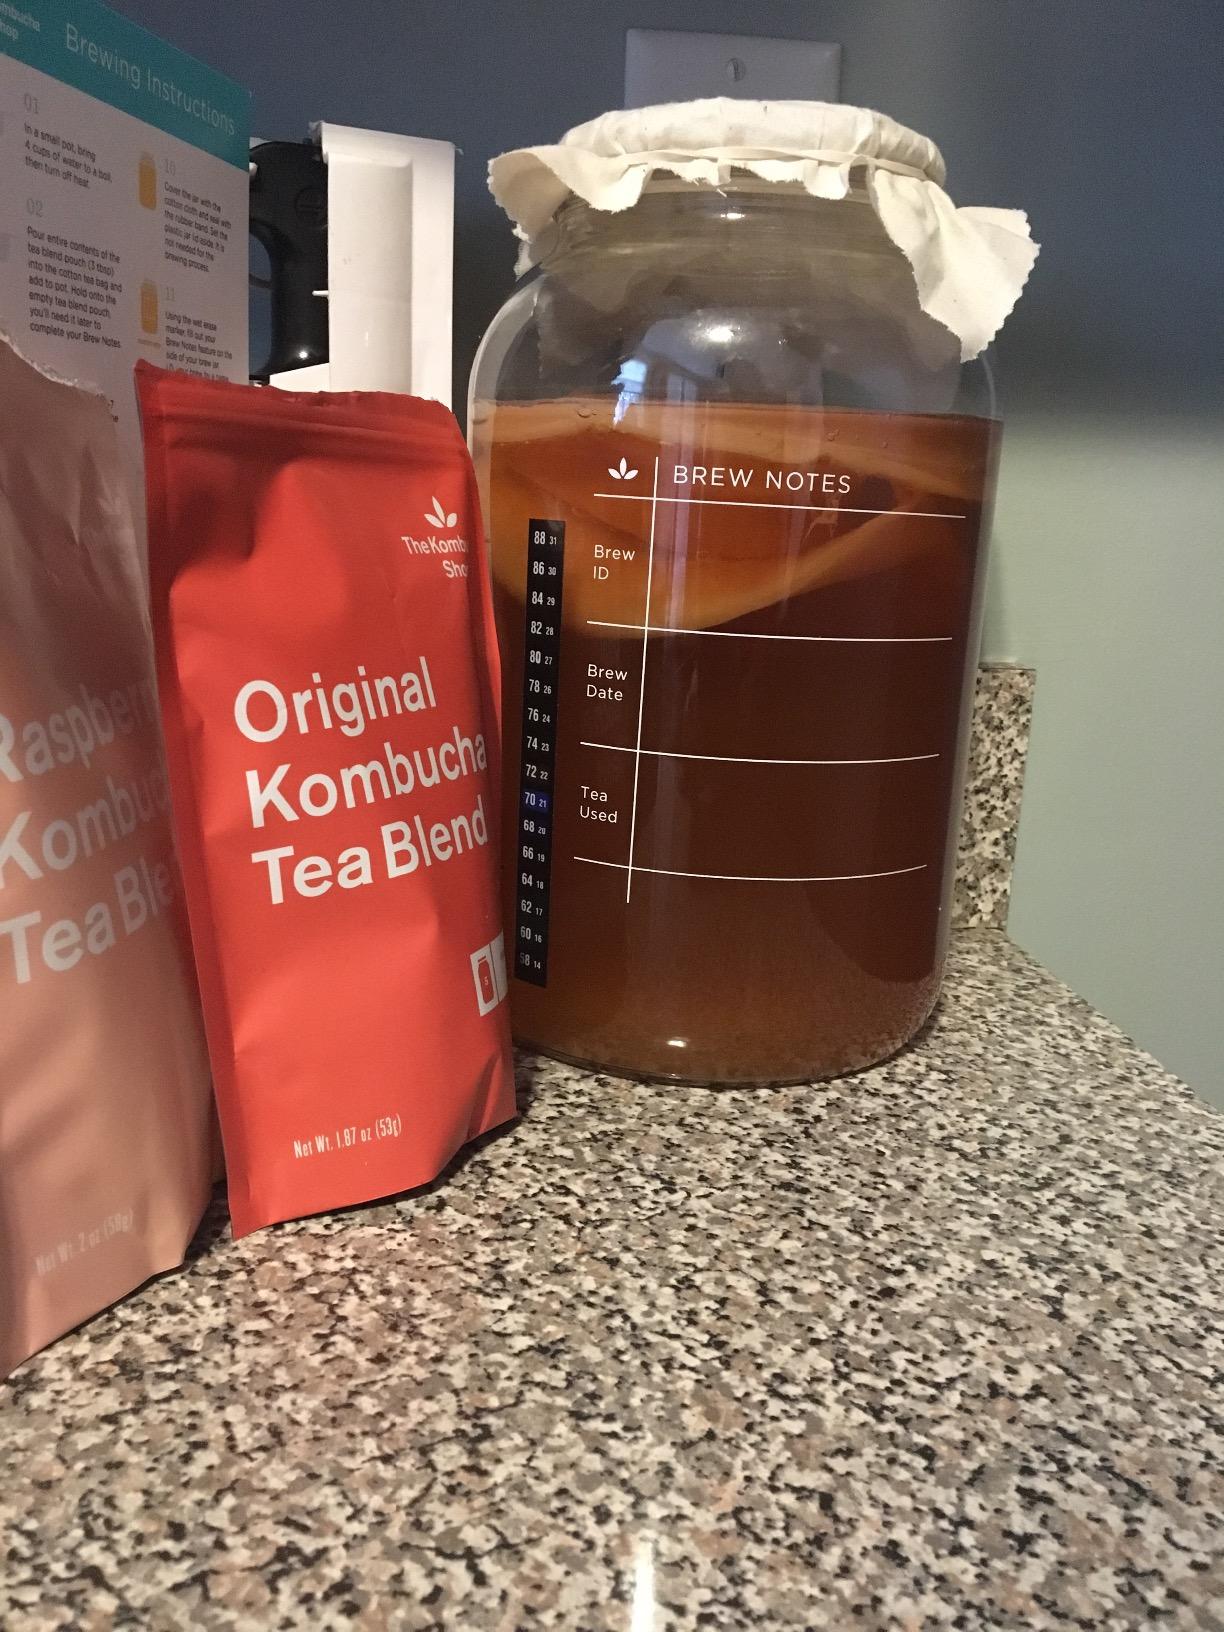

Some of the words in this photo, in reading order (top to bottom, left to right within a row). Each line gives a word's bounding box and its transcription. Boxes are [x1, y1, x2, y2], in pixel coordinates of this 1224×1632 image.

[65, 22, 142, 90] Brewing
[147, 67, 236, 136] Instructions
[41, 131, 61, 145] small
[77, 144, 96, 163] bring
[32, 144, 51, 159] cups
[62, 157, 82, 170] water
[25, 155, 44, 170] then
[44, 162, 61, 177] turn
[164, 181, 181, 196] Cover
[26, 198, 43, 218] 02
[27, 225, 46, 240] Pour
[47, 234, 68, 248] entire
[70, 241, 100, 258] contents
[109, 250, 121, 264] the
[28, 241, 40, 255] tea
[41, 246, 63, 262] blend
[64, 254, 87, 270] pouch
[28, 259, 44, 272] into
[45, 262, 57, 275] the
[58, 268, 82, 281] cotton
[83, 274, 95, 286] tea
[95, 278, 109, 291] bag
[110, 282, 122, 293] and
[28, 275, 44, 287] add
[70, 285, 88, 299] Hold
[88, 291, 105, 303] onto
[105, 294, 117, 306] the
[28, 291, 53, 306] empty
[54, 295, 67, 308] tea
[68, 299, 88, 313] blend
[51, 311, 69, 323] need
[77, 316, 93, 328] later
[164, 311, 182, 324] Using
[30, 322, 65, 337] complete
[66, 330, 82, 341] your
[83, 331, 101, 344] Brew
[165, 336, 180, 348] Brew
[673, 465, 754, 489] BREW
[765, 470, 852, 494] NOTES
[534, 531, 546, 544] 88
[550, 536, 557, 545] 31
[594, 544, 636, 561] Brew
[533, 561, 544, 575] 86
[548, 566, 556, 576] 30
[593, 565, 610, 580] ID
[532, 591, 543, 605] 84
[547, 597, 555, 606] 29
[530, 621, 542, 634] 82
[545, 627, 554, 636] 28
[530, 650, 541, 664] 80
[544, 656, 552, 665] 27
[587, 663, 628, 681] Brew
[529, 679, 540, 693] 78
[543, 686, 552, 694] 26
[586, 684, 624, 701] Date
[233, 655, 437, 743] Original
[528, 708, 539, 722] 76
[542, 714, 550, 723] 24
[527, 736, 538, 750] 74
[541, 743, 549, 752] 23
[245, 725, 488, 829] Kombucha
[525, 764, 537, 778] 72
[540, 771, 548, 780] 22
[524, 792, 536, 806] 70
[539, 799, 547, 808] 21
[581, 785, 608, 802] Tea
[580, 805, 618, 823] Used
[523, 820, 534, 833] 68
[538, 826, 546, 835] 20
[251, 845, 374, 905] Tea
[380, 794, 489, 879] Blend
[522, 846, 534, 860] 66
[538, 854, 545, 862] 19
[522, 873, 532, 887] 64
[536, 881, 544, 890] 18
[521, 900, 532, 914] 62
[536, 907, 543, 916] 17
[0, 902, 117, 984] Tea
[113, 855, 174, 936] Ble
[520, 926, 531, 940] 60
[534, 934, 542, 943] 16
[534, 960, 541, 969] 14
[293, 1140, 313, 1159] Net
[315, 1134, 334, 1153] Wt.
[335, 1126, 357, 1149] 1.87
[360, 1128, 372, 1143] oz
[375, 1112, 402, 1140] (53g)
[78, 1231, 87, 1253] 2
